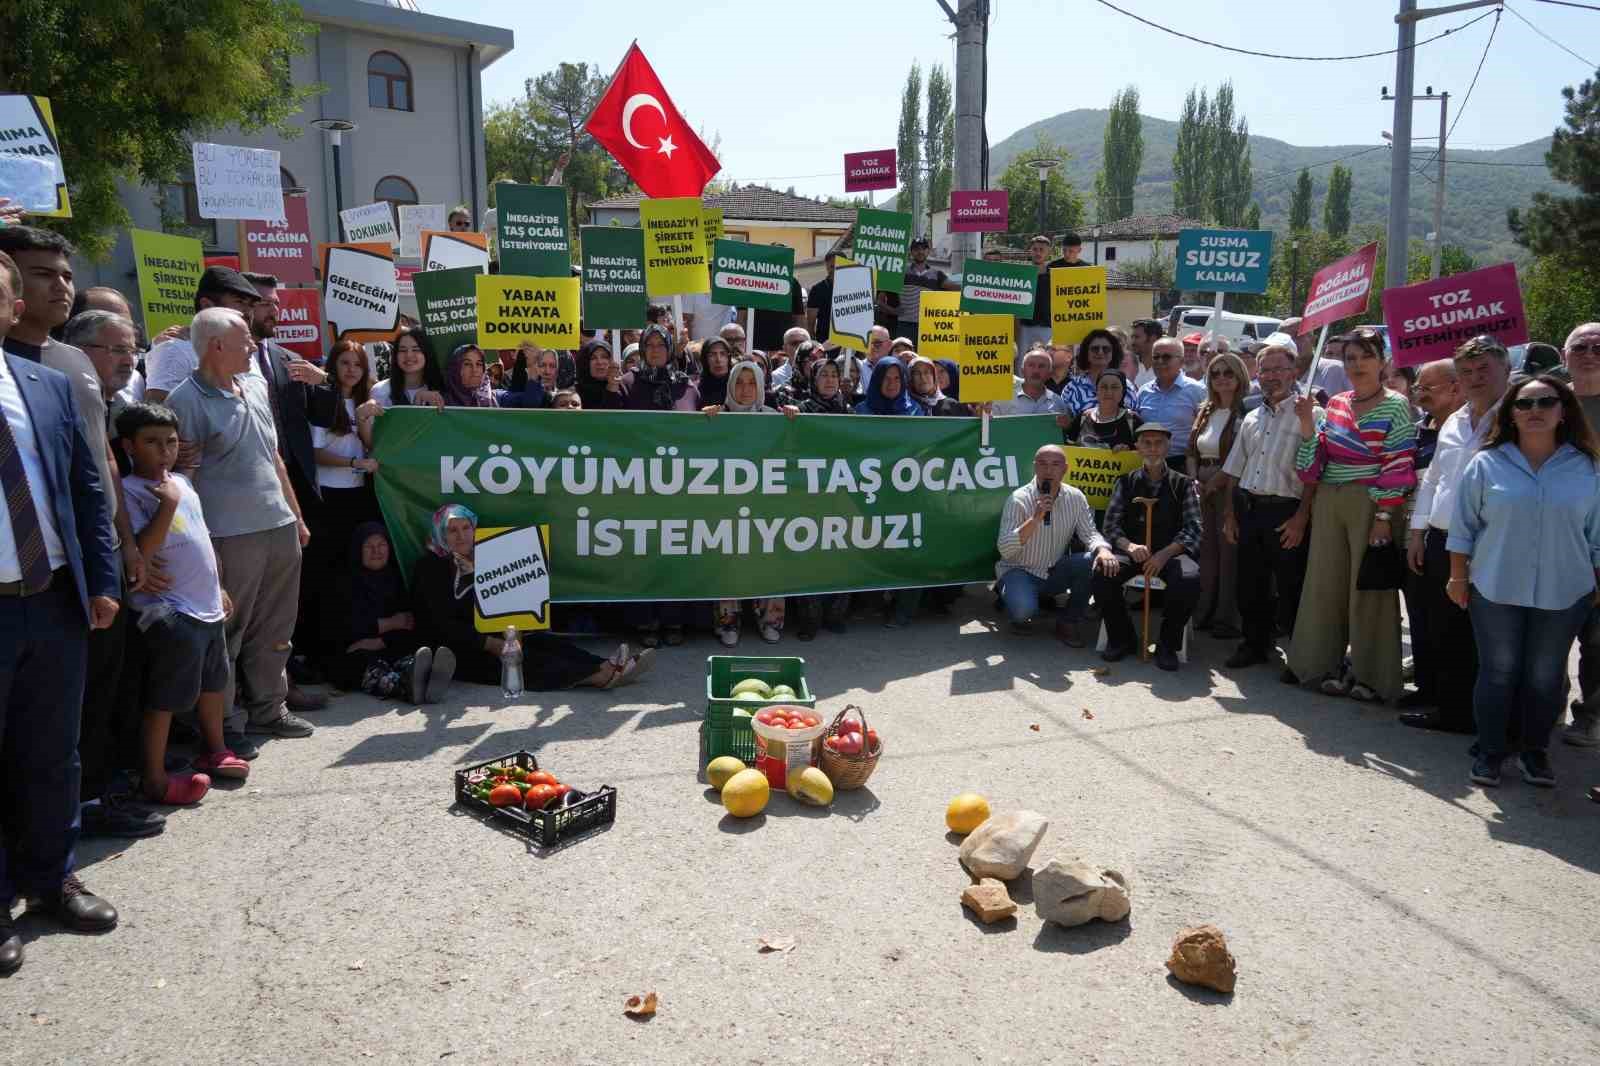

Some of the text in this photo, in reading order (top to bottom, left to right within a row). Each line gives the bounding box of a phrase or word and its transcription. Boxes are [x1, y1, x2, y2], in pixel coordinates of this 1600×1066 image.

[862, 158, 879, 167] TOZ
[850, 166, 891, 177] SOLUMAK
[970, 199, 988, 207] TOZ
[957, 207, 1001, 216] SOLUMAK
[247, 230, 309, 243] OCAĞINA
[349, 221, 394, 241] DOKUNMA
[503, 225, 564, 238] TAŞ OCAĞI
[860, 224, 906, 240] DOĞANIN
[501, 239, 568, 251] İSTEMİYORUZ!
[856, 239, 906, 254] TALANINA
[1199, 236, 1249, 248] SUSMA
[256, 247, 304, 258] HAYIR!
[1185, 249, 1261, 268] SUSUZ
[718, 257, 789, 276] ORMANIMA
[854, 252, 905, 273] HAYIR
[586, 267, 641, 280] TAŞ OCAĞI
[1195, 270, 1247, 283] KALMA
[584, 283, 644, 293] İSTEMİYORUZ!
[727, 277, 779, 291] DOKUNMA!
[966, 273, 1033, 290] ORMANIMA
[502, 289, 556, 301] YABAN
[973, 289, 1022, 302] DOKUNMA!
[1055, 283, 1100, 296] İNEGAZİ
[332, 288, 386, 314] TOZUTMA
[833, 289, 872, 304] ORMANIMA
[1428, 288, 1472, 309] TOZ
[147, 301, 195, 316] ETMİYOR
[834, 302, 873, 318] DOKUNMA
[1067, 299, 1090, 309] YOK
[425, 307, 478, 322] TAŞ OCA
[499, 306, 560, 318] HAYATA
[924, 306, 961, 318] İNEGAZ
[1053, 311, 1104, 322] OLMASIN
[1403, 301, 1505, 333] SOLUMAK
[425, 322, 478, 336] İSTEMİYOR
[485, 322, 573, 335] DOKUNMA!
[934, 321, 954, 330] YOK
[964, 333, 1009, 346] İNEGAZİ
[1397, 316, 1518, 350] İSTEMİYORUZ!
[975, 350, 998, 360] YOK
[962, 365, 1011, 376] OLMASIN
[1075, 457, 1122, 471] YABAN
[439, 445, 1020, 504] KÖYÜMÜZDE TAŞ OCAĞI
[575, 506, 923, 556] İSTEMİYORUZ!
[476, 553, 541, 585] ORMANIMA
[480, 566, 547, 600] DOKUNMA
